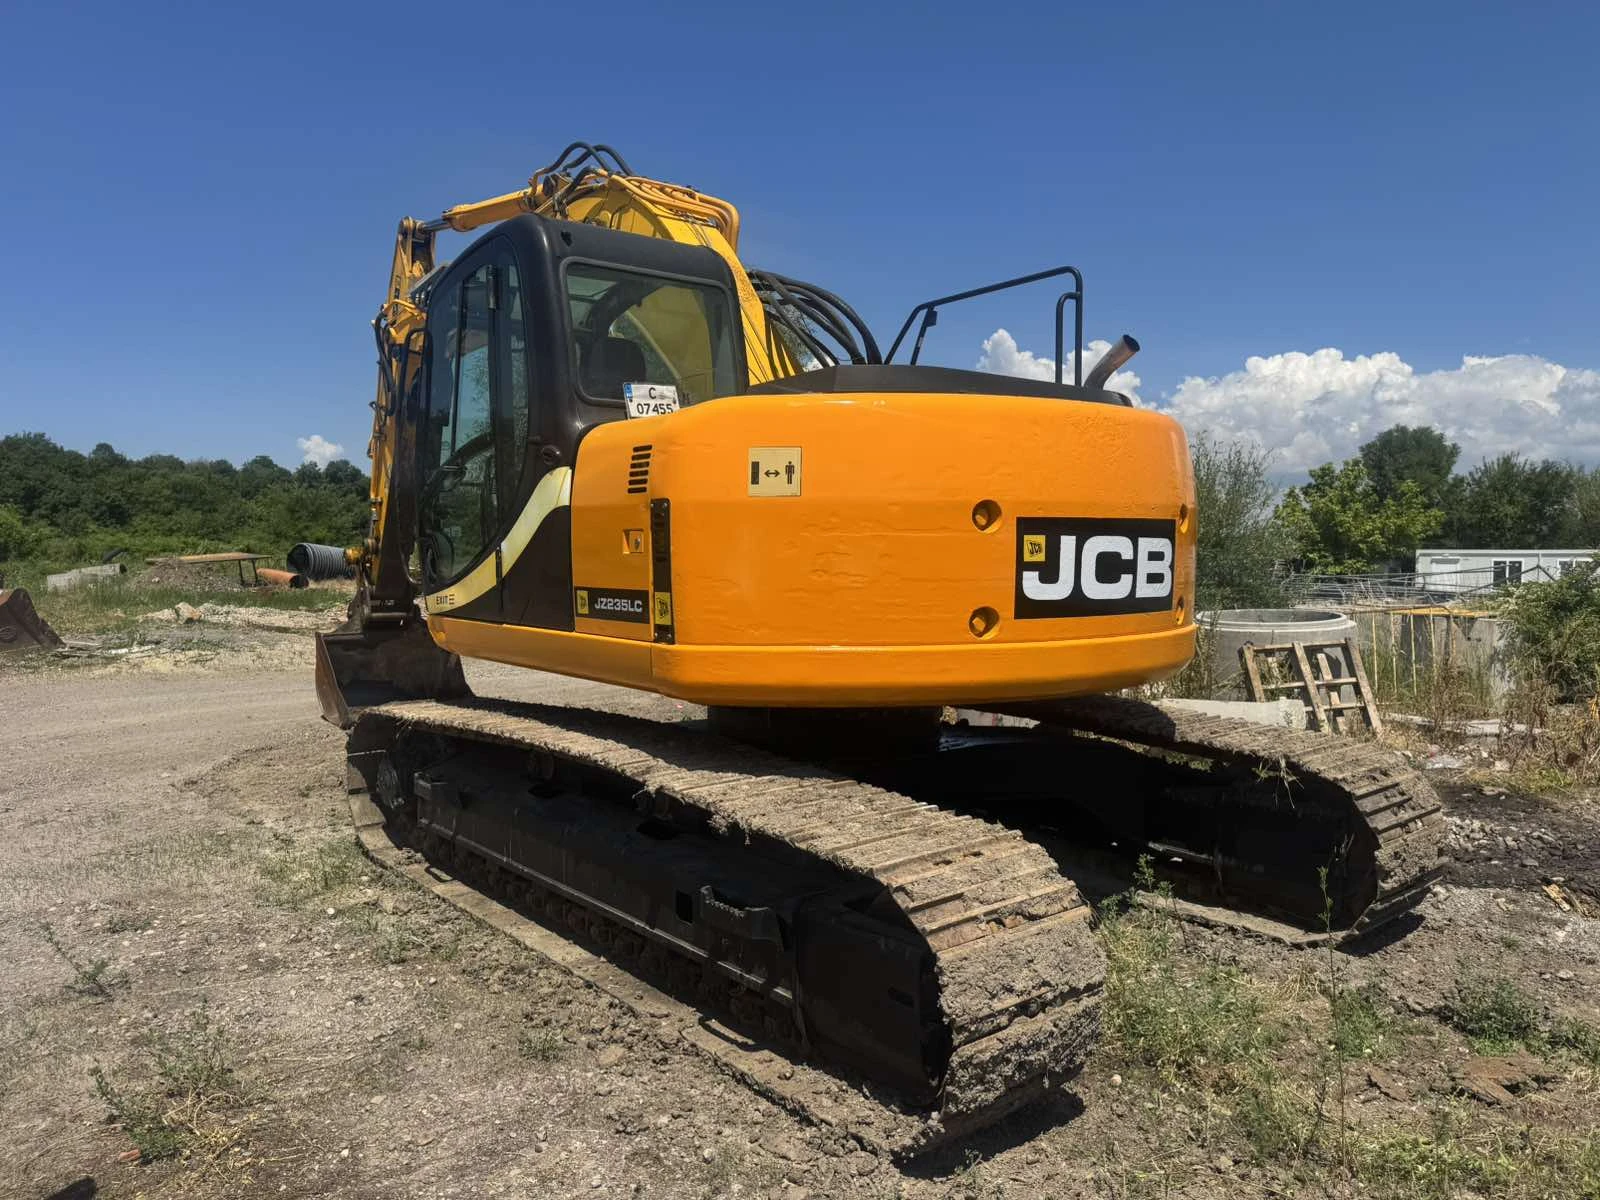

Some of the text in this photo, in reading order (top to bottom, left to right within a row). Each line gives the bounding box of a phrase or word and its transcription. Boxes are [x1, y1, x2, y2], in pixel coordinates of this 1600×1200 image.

[648, 387, 657, 399] C
[636, 403, 674, 415] 07455
[1022, 535, 1173, 600] JCB
[594, 598, 643, 612] JZ235LC
